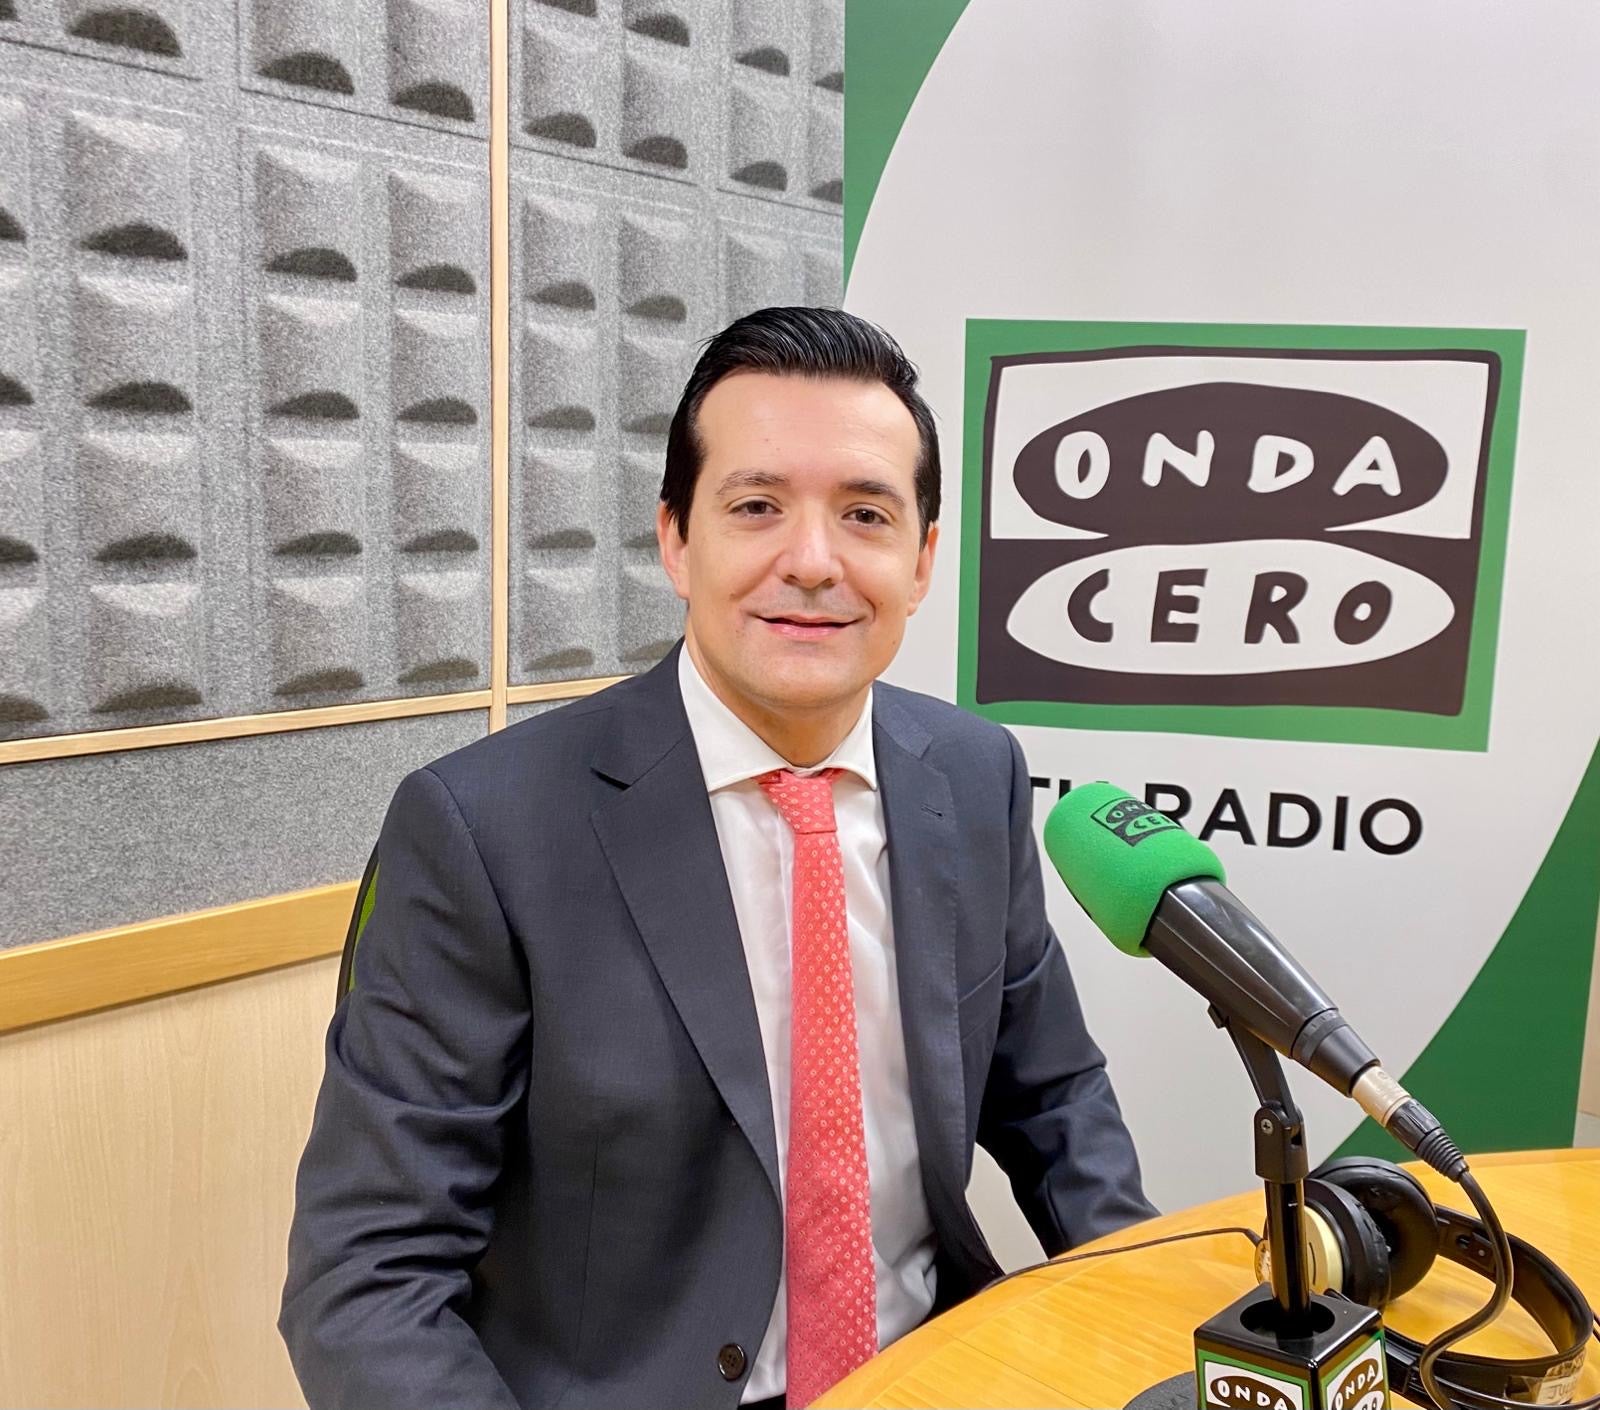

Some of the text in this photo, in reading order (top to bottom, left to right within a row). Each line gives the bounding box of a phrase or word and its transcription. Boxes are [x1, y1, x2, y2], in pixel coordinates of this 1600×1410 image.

[1054, 430, 1402, 499] ONDA
[1067, 568, 1393, 645] CERO
[1144, 783, 1423, 856] RADIO
[1217, 1380, 1288, 1410] ONDA
[1335, 1364, 1376, 1410] ONDA
